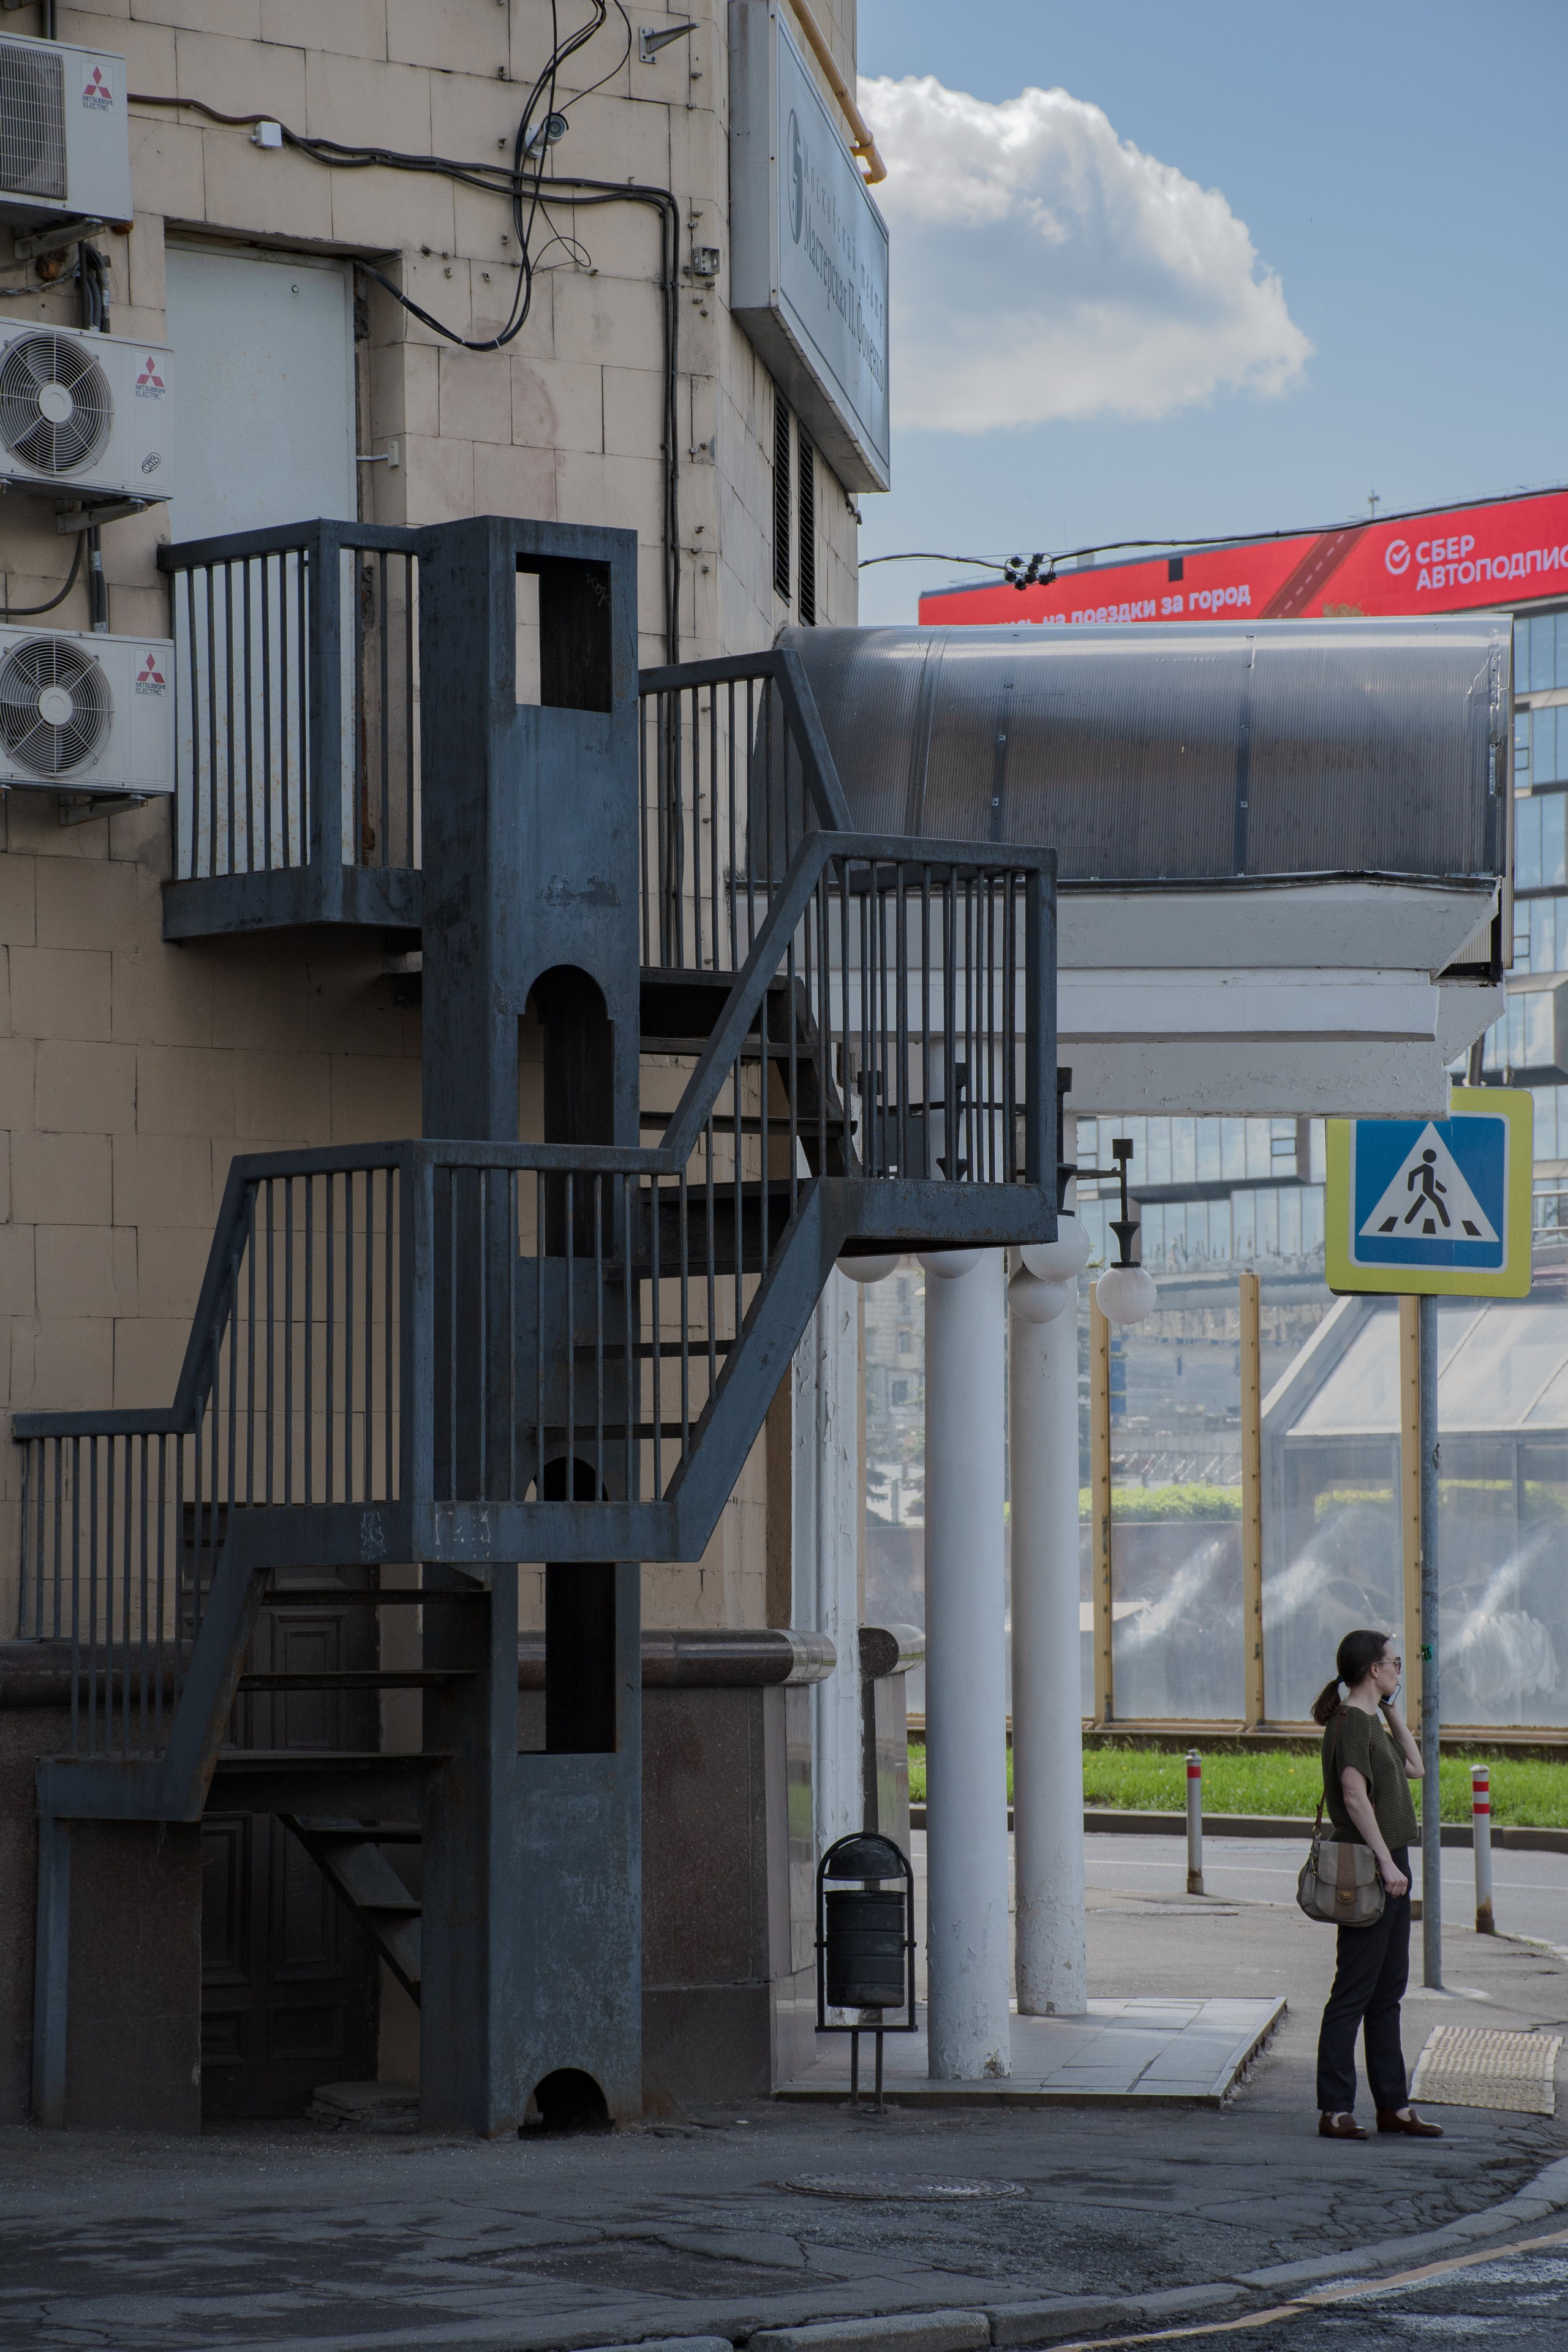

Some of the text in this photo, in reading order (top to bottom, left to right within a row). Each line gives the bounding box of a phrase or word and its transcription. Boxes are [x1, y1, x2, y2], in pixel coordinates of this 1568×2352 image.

[83, 95, 113, 105] MITSUBISHI
[83, 101, 109, 111] ELECTRIC
[803, 138, 856, 273] Московский
[804, 195, 847, 323] Мастерская
[857, 294, 883, 393] Фоменко
[135, 384, 165, 394] MITSUBISHI
[135, 390, 161, 399] ELECTRIC
[1415, 535, 1475, 565] СБЕР
[1071, 598, 1156, 624] поездки
[1161, 595, 1183, 615] за
[1189, 584, 1251, 614] город
